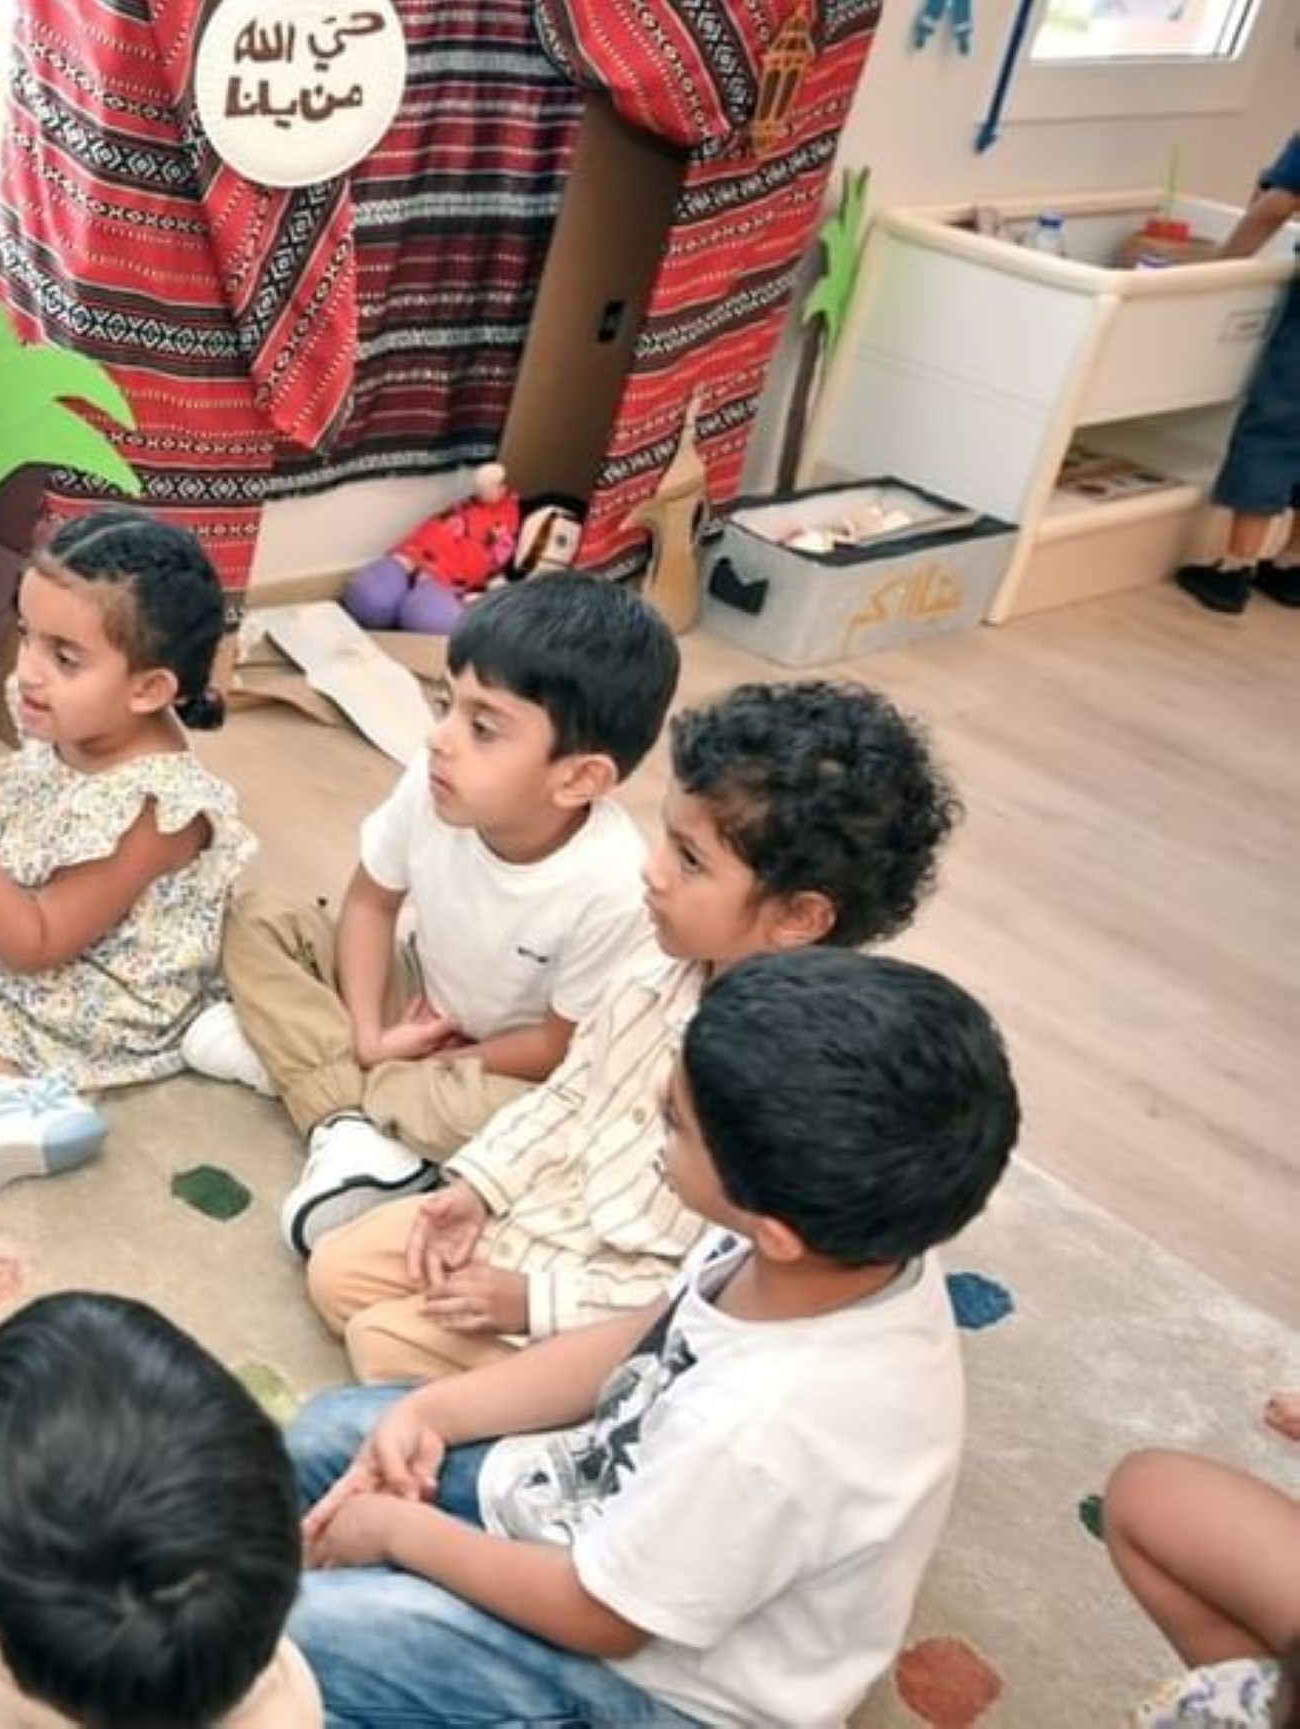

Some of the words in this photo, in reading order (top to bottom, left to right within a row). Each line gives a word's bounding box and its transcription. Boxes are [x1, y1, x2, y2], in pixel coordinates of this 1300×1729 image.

[234, 18, 296, 63] الله
[225, 76, 298, 129] يانا
[301, 85, 362, 121] من
